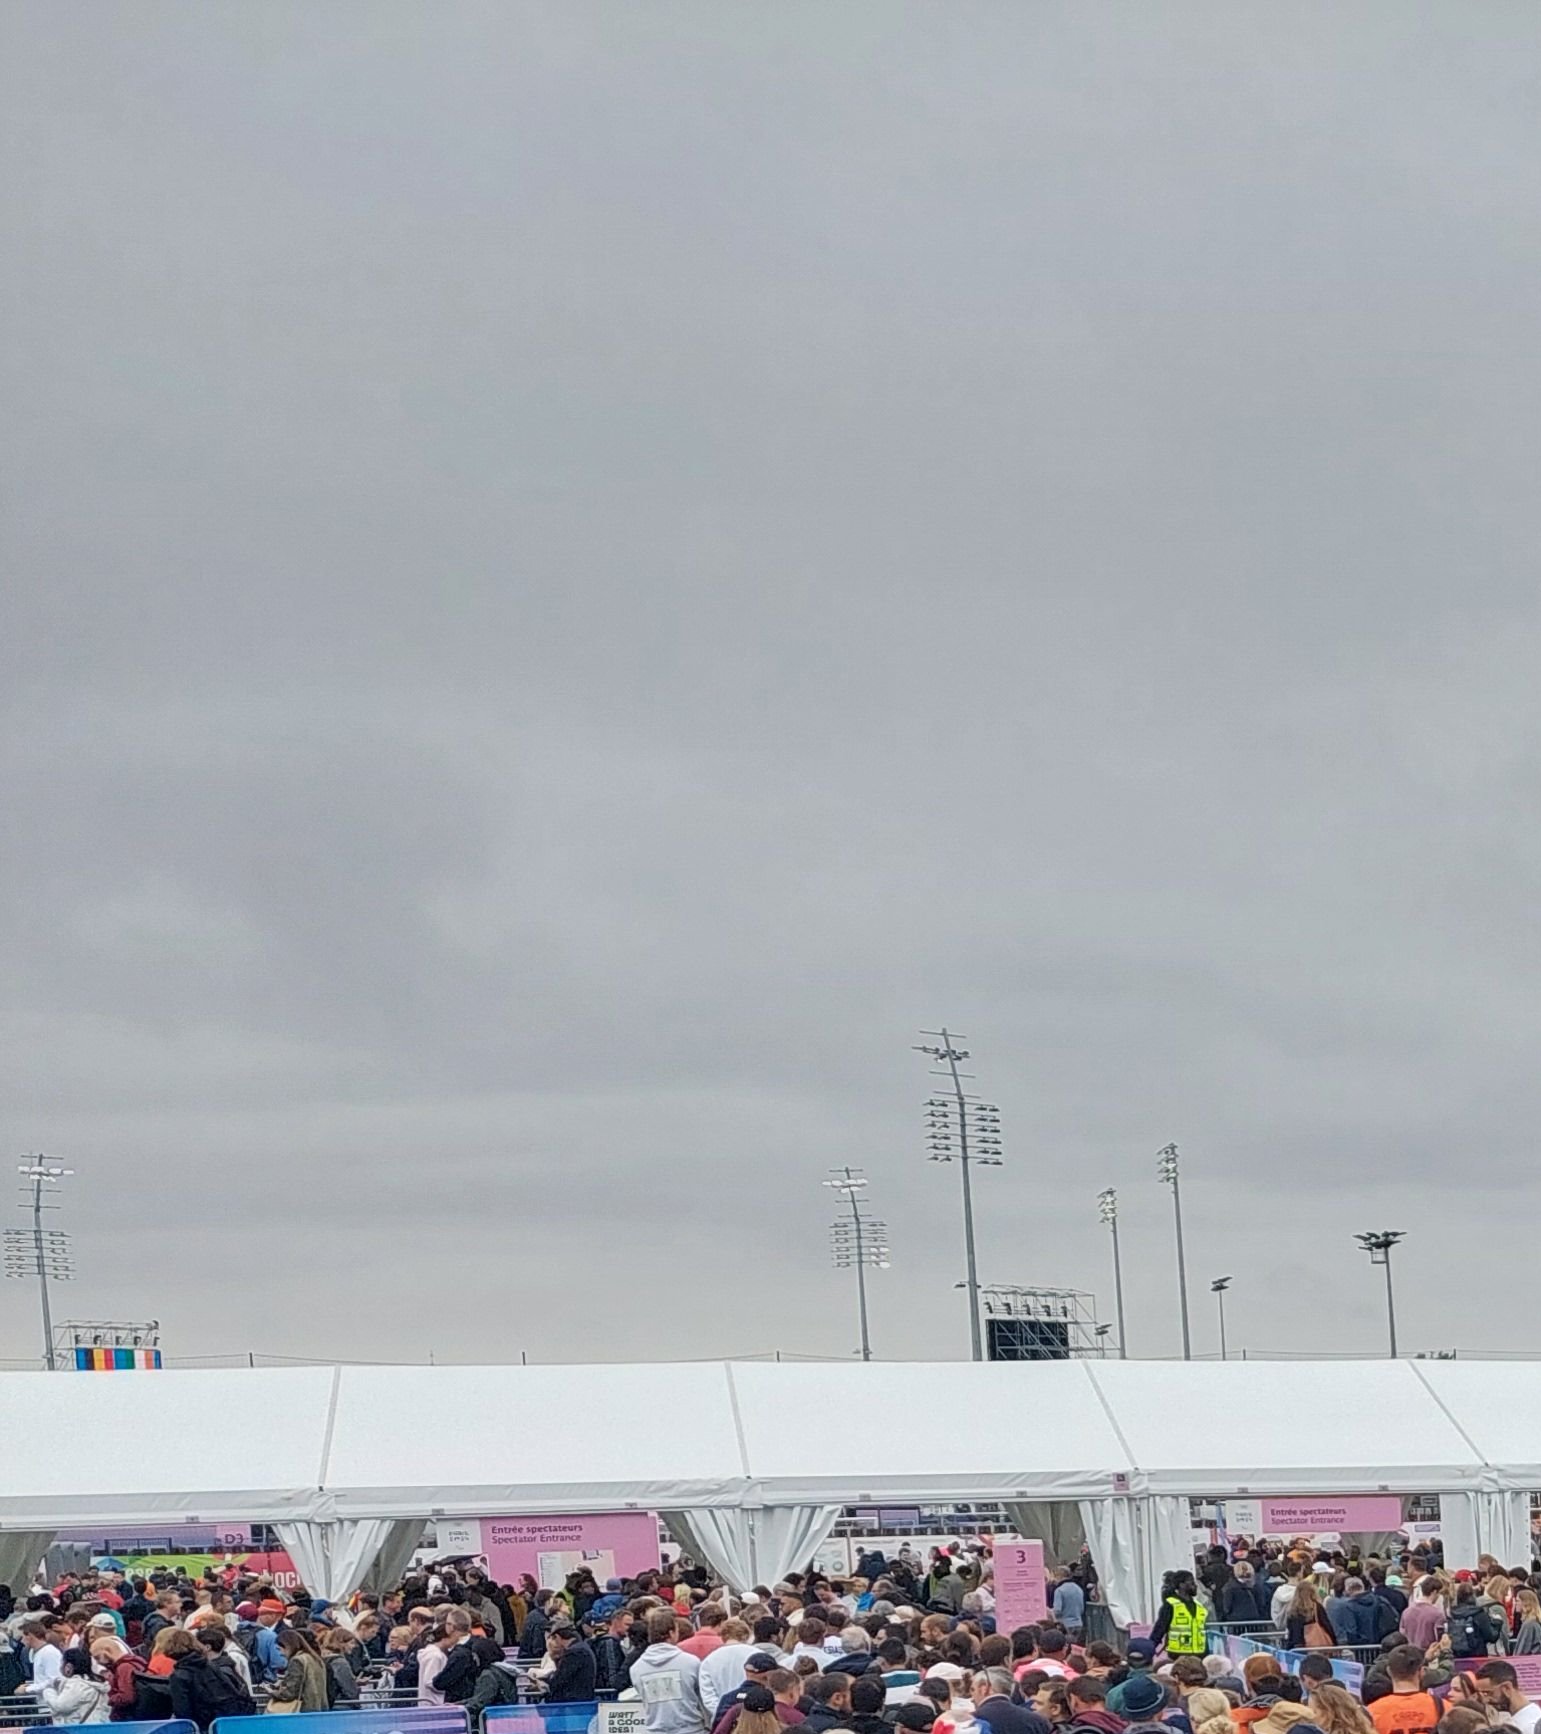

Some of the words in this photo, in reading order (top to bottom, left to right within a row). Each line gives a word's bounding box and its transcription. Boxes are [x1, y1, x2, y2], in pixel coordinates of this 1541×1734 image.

[1271, 1507, 1298, 1516] Entrée
[1299, 1507, 1347, 1518] spectateurs
[1271, 1517, 1308, 1526] Spectator
[1310, 1516, 1345, 1525] Entrance
[491, 1525, 524, 1535] Entrée
[526, 1524, 583, 1535] spectateurs
[224, 1533, 244, 1545] D3
[492, 1535, 538, 1545] Spectator
[540, 1534, 582, 1543] Entrance
[1015, 1550, 1026, 1564] 3
